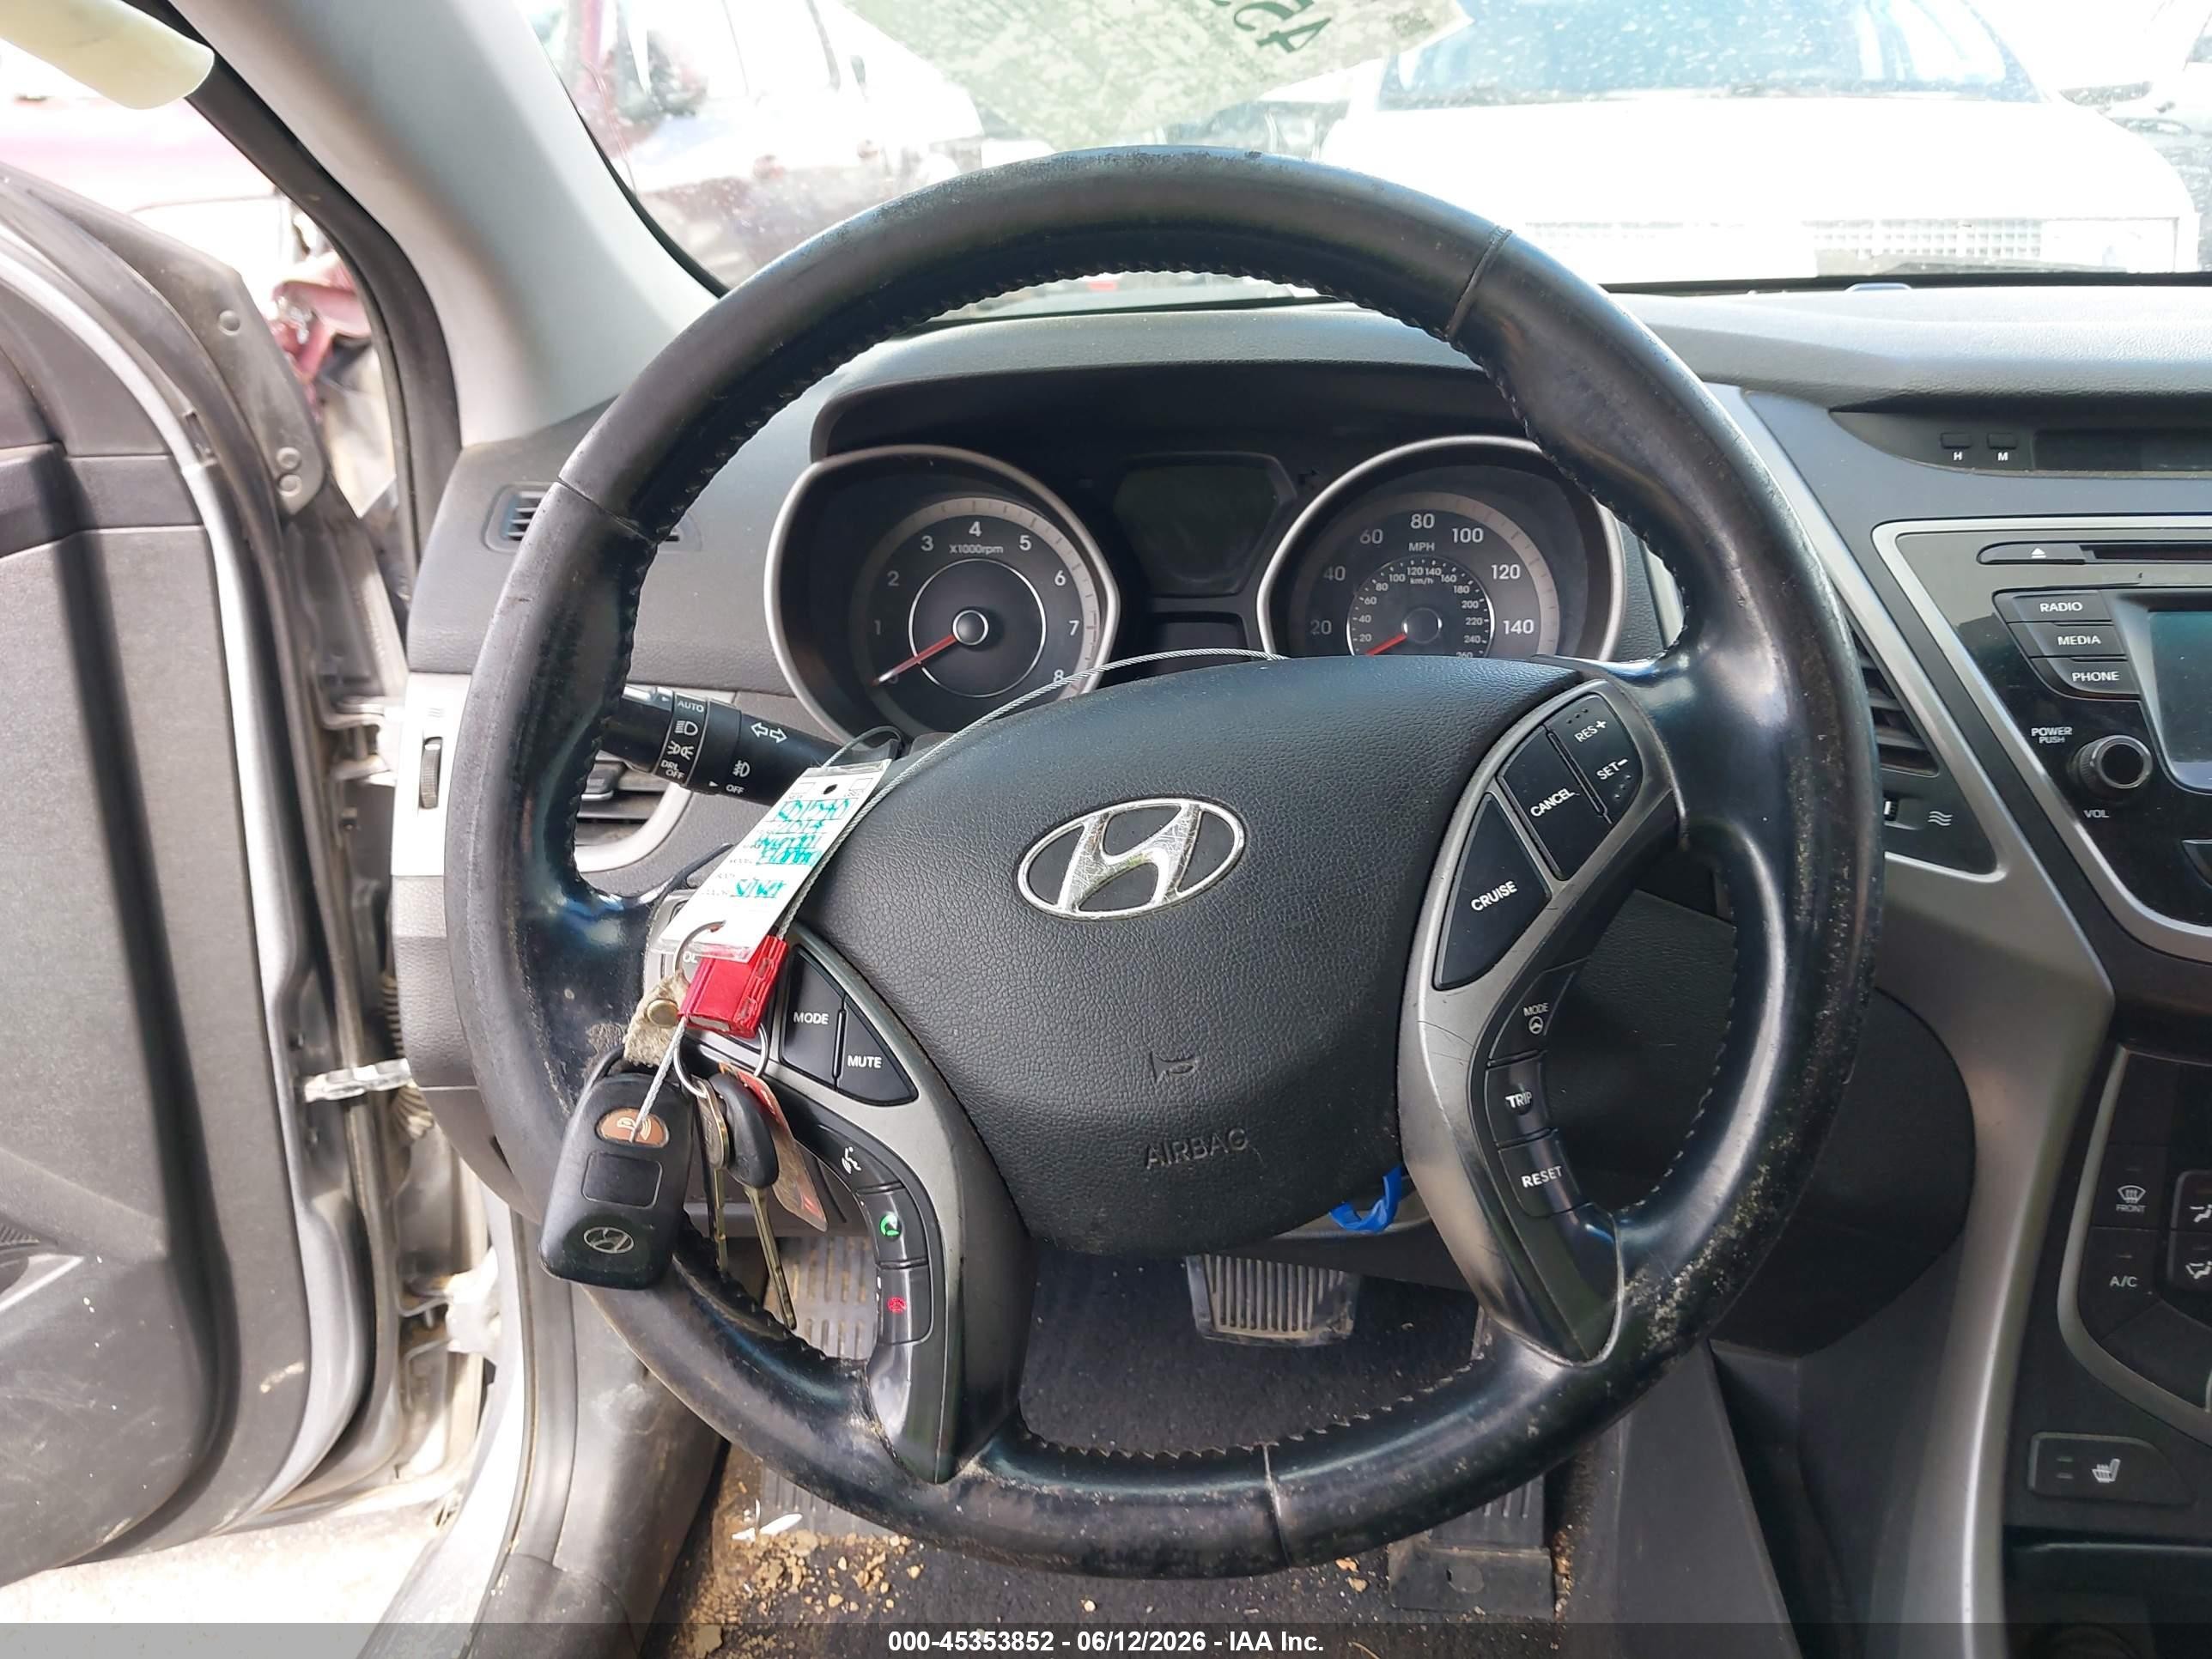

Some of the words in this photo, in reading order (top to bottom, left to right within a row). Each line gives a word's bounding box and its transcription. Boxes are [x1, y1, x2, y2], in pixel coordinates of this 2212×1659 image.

[1954, 452, 1963, 461] H
[1997, 452, 2008, 461] M
[1410, 514, 1435, 530] 80
[969, 521, 982, 537] 4
[1359, 529, 1383, 544] 60
[1451, 528, 1484, 544] 100
[921, 536, 934, 551] 3
[1019, 536, 1031, 551] 5
[1408, 542, 1435, 552] MPH
[1323, 565, 1346, 581] 40
[1407, 567, 1424, 576] 120
[1425, 567, 1442, 576] 140
[1491, 564, 1521, 580] 120
[887, 571, 900, 586] 2
[1054, 571, 1066, 586] 6
[1389, 574, 1406, 583] 100
[1409, 576, 1434, 585] km/h
[1440, 574, 1457, 583] 160
[1375, 582, 1389, 592] 80
[1453, 585, 1470, 594] 180
[1364, 596, 1377, 605] 60
[1461, 600, 1480, 609] 200
[2039, 601, 2083, 613] RADIO
[1358, 614, 1372, 623] 40
[1465, 617, 1483, 626] 220
[874, 619, 882, 635] 1
[1069, 619, 1079, 636] 7
[1310, 619, 1333, 635] 20
[1502, 619, 1534, 635] 140
[1359, 634, 1372, 642] 20
[1463, 635, 1482, 644] 240
[2057, 635, 2101, 647] MEDIA
[1054, 669, 1064, 684] 8
[2071, 671, 2120, 683] PHONE
[677, 700, 705, 714] AUTO
[2031, 726, 2073, 738] POWER
[2039, 736, 2066, 744] PUSH
[660, 759, 680, 771] DRL
[665, 769, 685, 780] OFF
[726, 783, 745, 795] OFF
[1530, 787, 1576, 817] CANCEL
[2083, 809, 2110, 819] VOL
[1471, 880, 1518, 911] CRUISE
[1522, 1002, 1549, 1017] MODE
[793, 1012, 830, 1025] MODE
[847, 1054, 882, 1069] MUTE
[1505, 1091, 1533, 1109] TRIP
[1145, 1127, 1249, 1170] AIRBAG
[1521, 1165, 1563, 1188] RESET
[2115, 1204, 2146, 1213] FRONT
[2109, 1276, 2138, 1287] A/C
